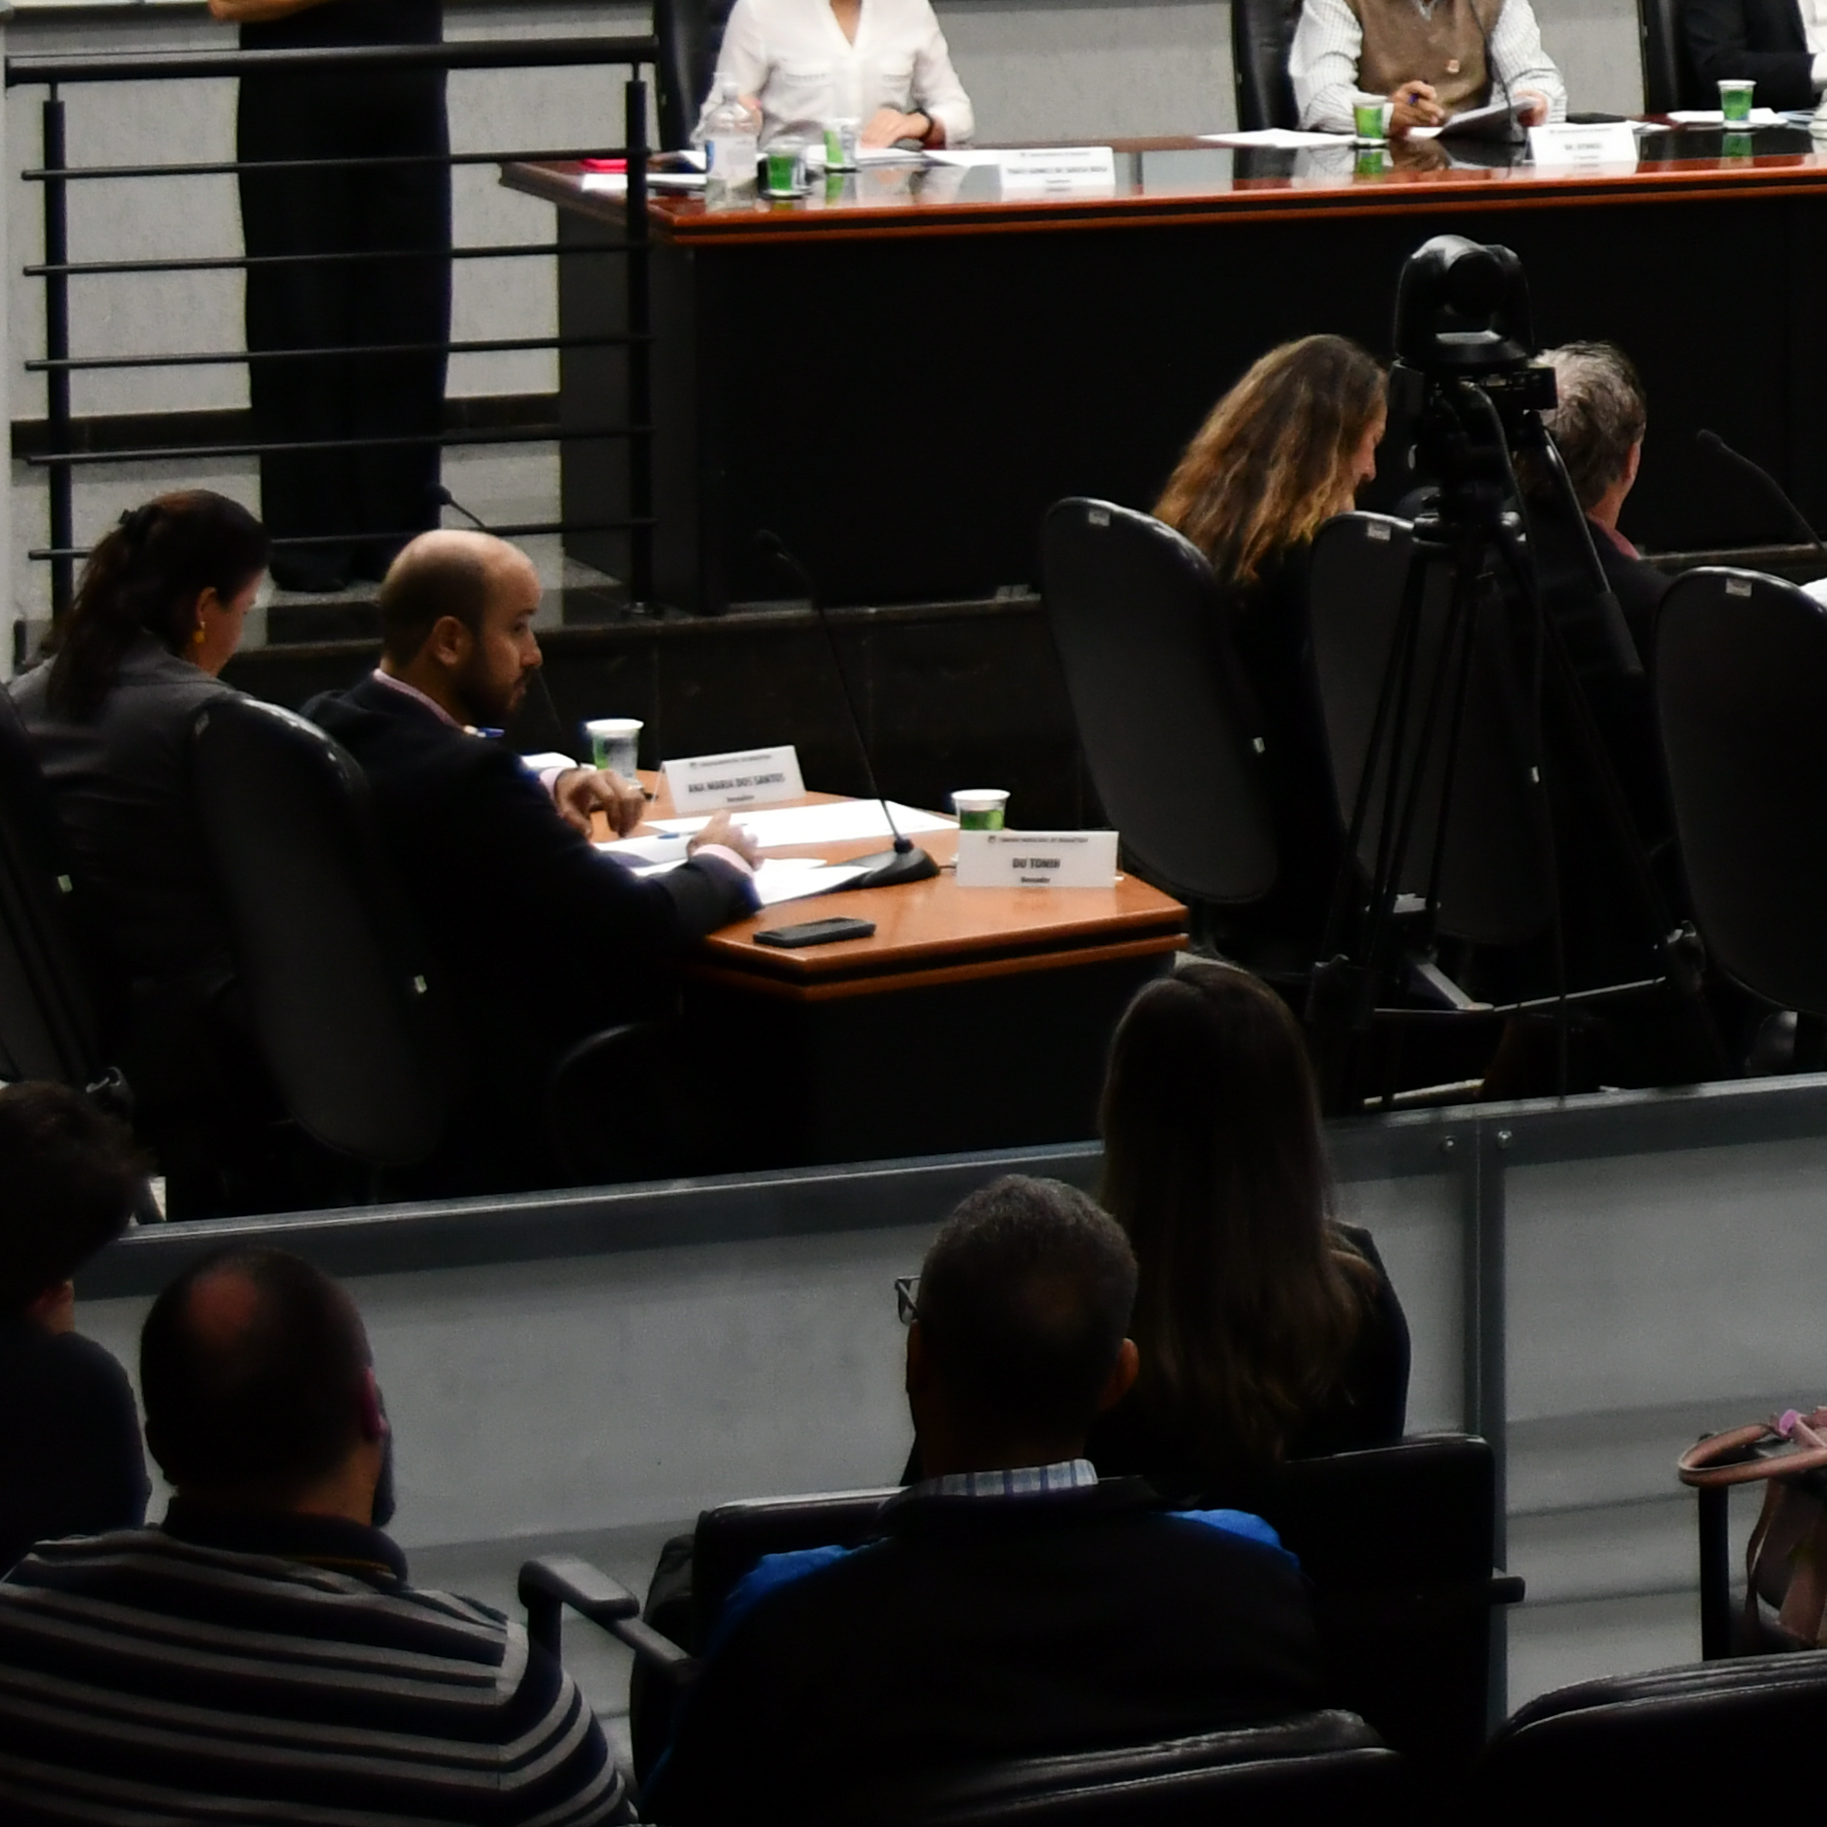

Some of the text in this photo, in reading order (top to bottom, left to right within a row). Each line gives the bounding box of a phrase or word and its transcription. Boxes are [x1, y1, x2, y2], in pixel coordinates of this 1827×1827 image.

[688, 772, 786, 793] ANA MARIA DOS SANTOS
[1011, 857, 1028, 869] DU
